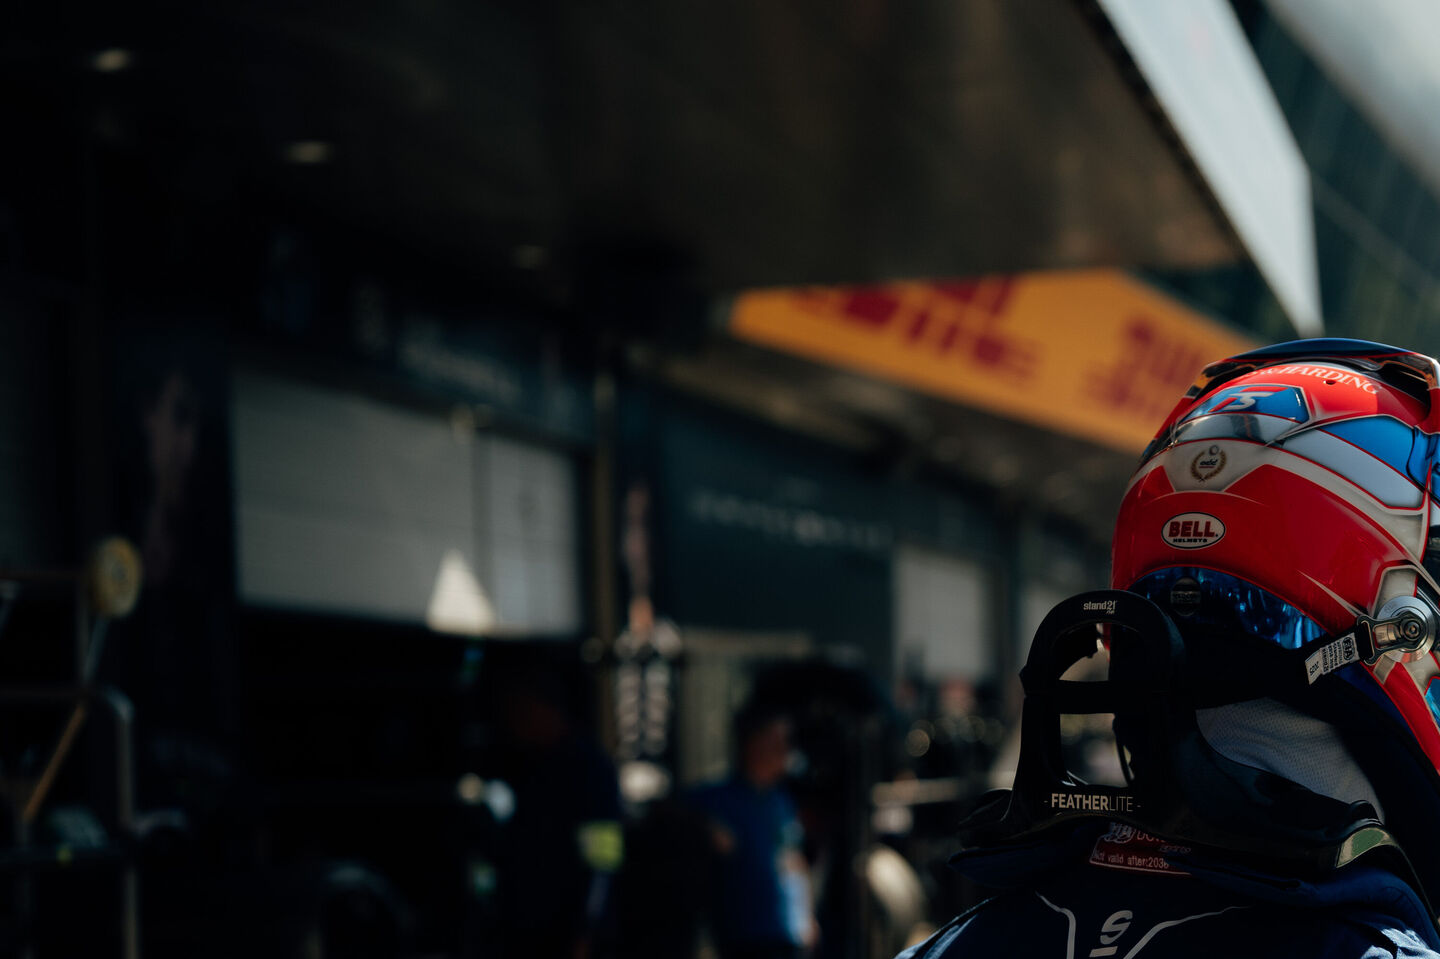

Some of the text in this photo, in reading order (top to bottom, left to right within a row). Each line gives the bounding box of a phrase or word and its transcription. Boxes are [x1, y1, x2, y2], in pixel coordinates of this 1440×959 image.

[1277, 366, 1379, 395] HARDING
[1168, 520, 1215, 538] BELL
[1051, 792, 1134, 813] FEATHERLITE
